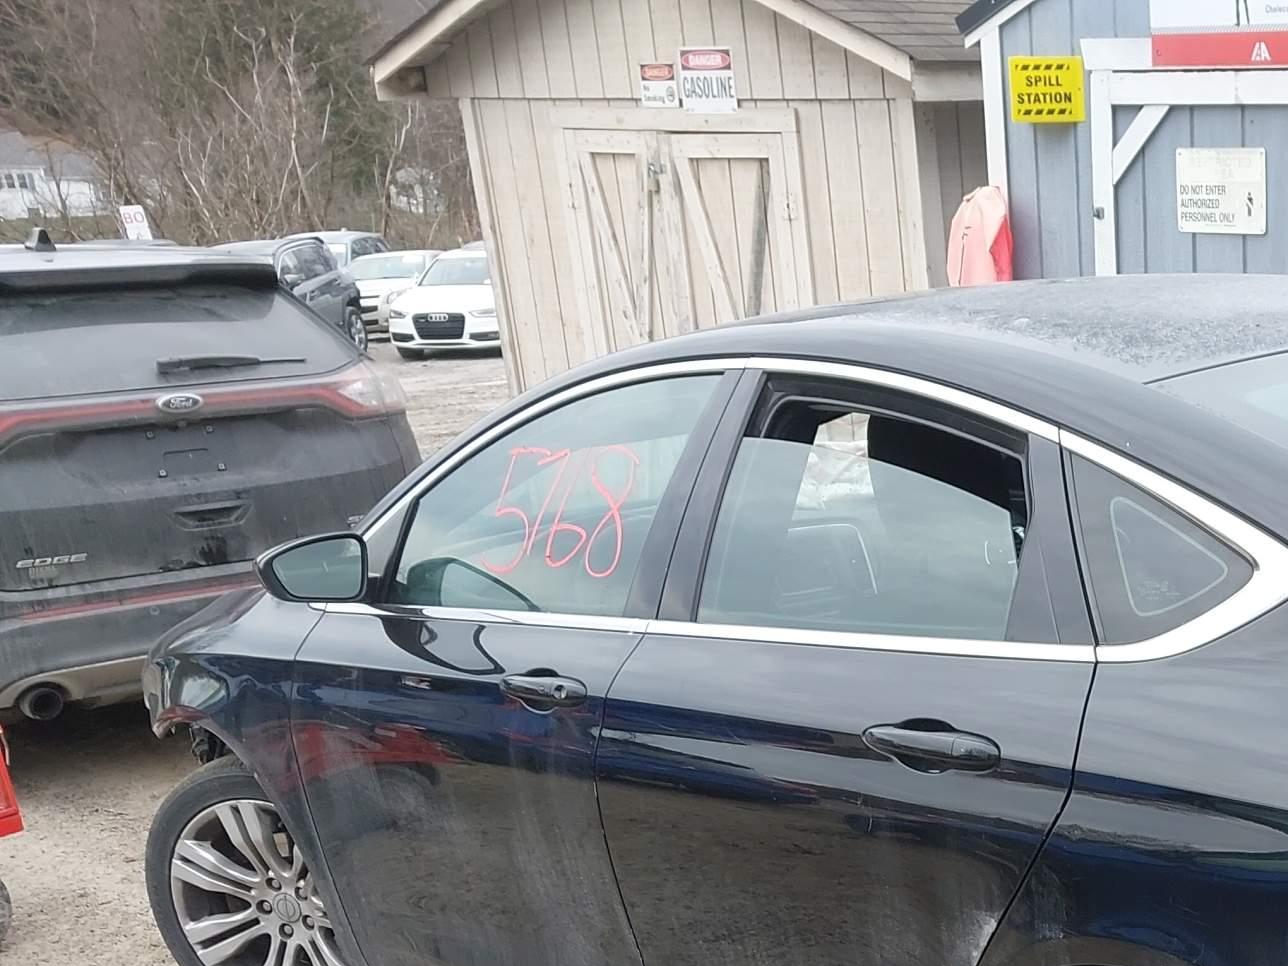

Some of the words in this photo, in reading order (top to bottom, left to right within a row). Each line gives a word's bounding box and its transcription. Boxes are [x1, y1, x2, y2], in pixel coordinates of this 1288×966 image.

[1025, 74, 1063, 87] SPILL
[682, 76, 735, 99] GASOLINE
[1017, 92, 1073, 105] STATION
[1179, 184, 1189, 195] DO
[1191, 184, 1203, 195] NOT
[1205, 184, 1226, 196] ENTER
[1181, 198, 1220, 209] AUTHORIZED
[1181, 211, 1217, 223] PERSONNEL
[1219, 212, 1235, 223] ONLY
[480, 444, 641, 578] 5768
[16, 553, 88, 569] EDGE
